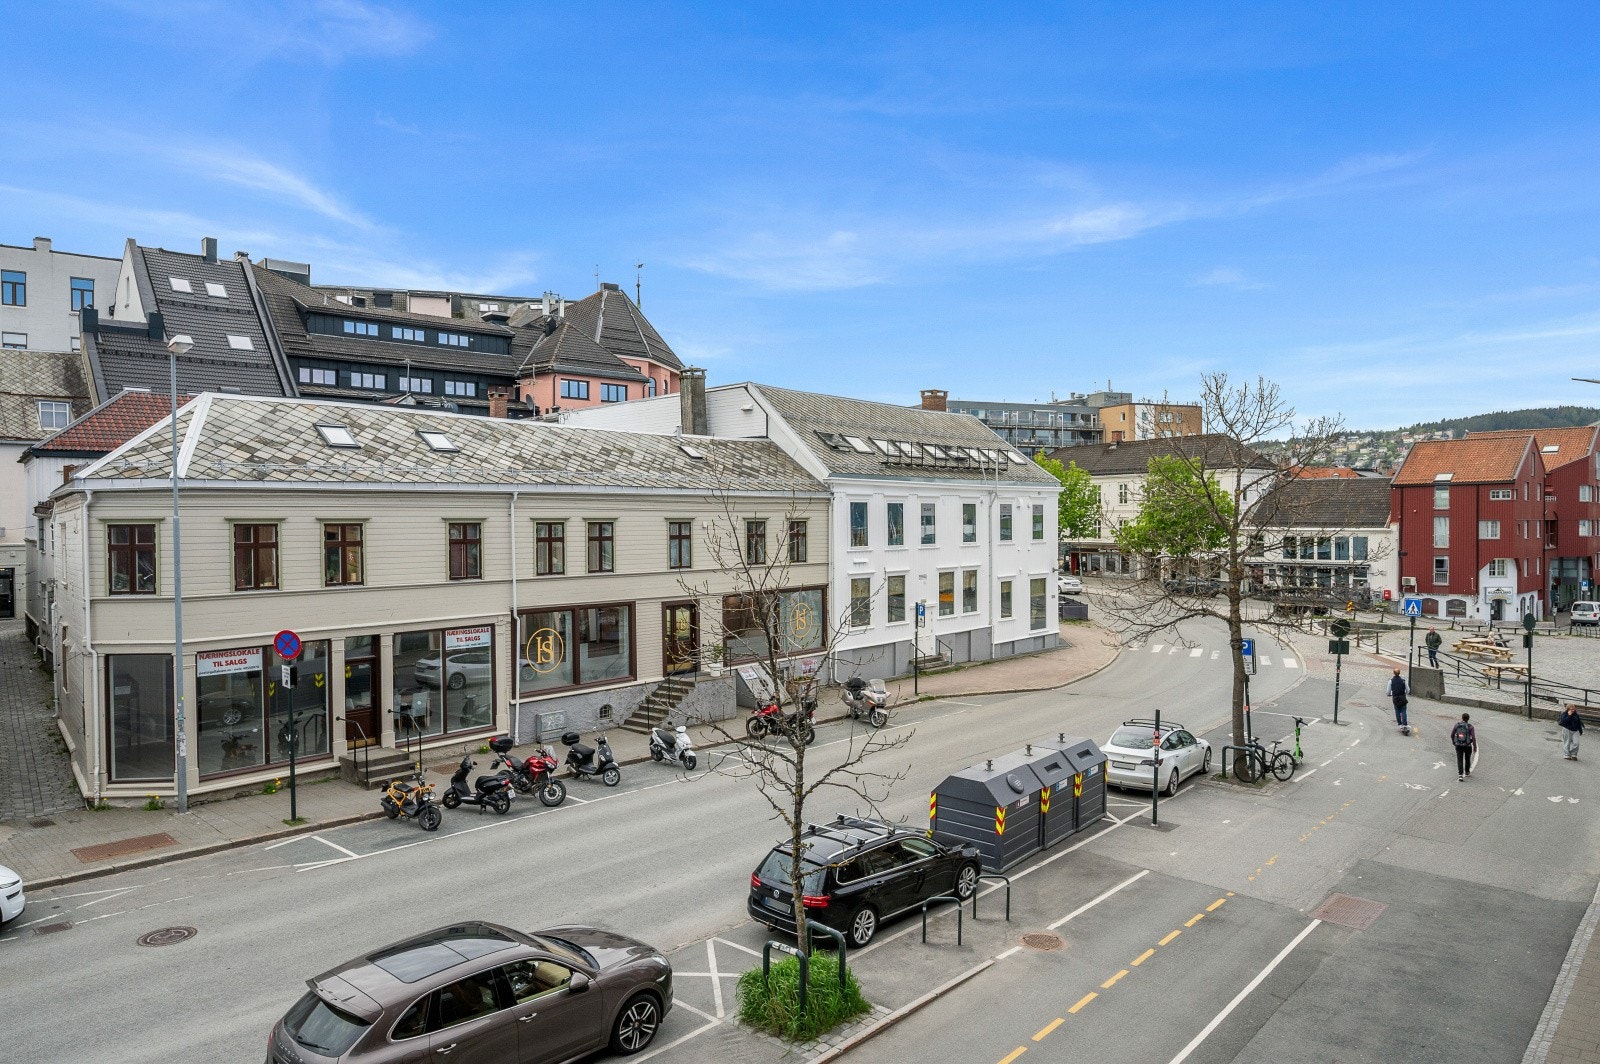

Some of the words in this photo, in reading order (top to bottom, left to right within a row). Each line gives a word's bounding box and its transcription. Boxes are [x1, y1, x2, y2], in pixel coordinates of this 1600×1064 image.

[447, 628, 489, 636] NÆRINGSLOKALE
[199, 649, 260, 660] NÆRINGSLOKALE
[225, 658, 247, 666] SALGS
